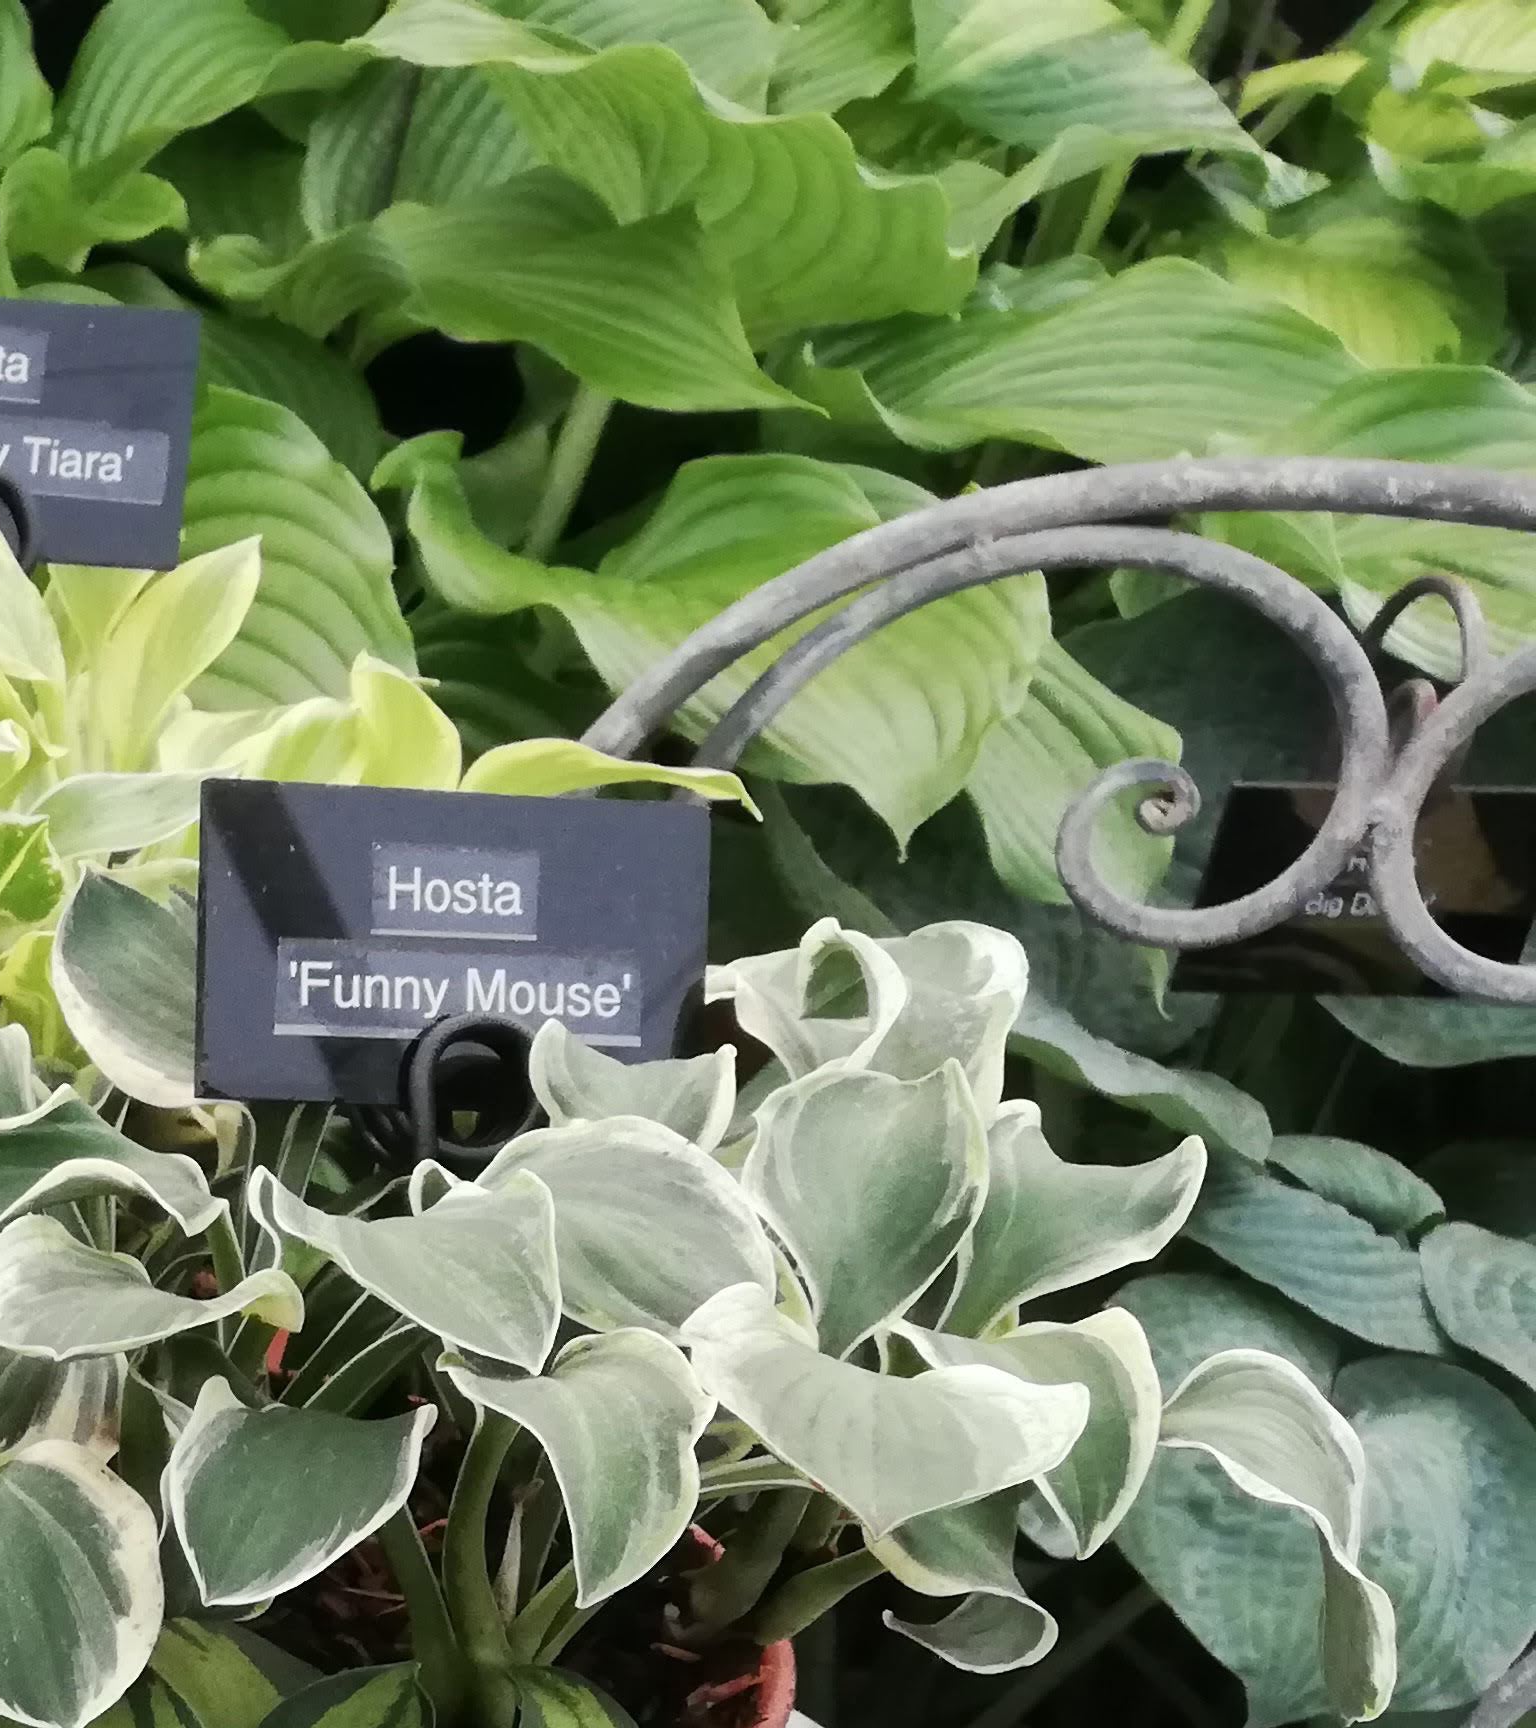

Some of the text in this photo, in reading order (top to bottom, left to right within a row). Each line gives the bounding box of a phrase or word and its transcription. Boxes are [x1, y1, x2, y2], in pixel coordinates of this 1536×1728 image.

[23, 435, 135, 483] Tiara'
[387, 866, 523, 916] Hosta
[289, 960, 632, 1018] 'Funny Mouse'
